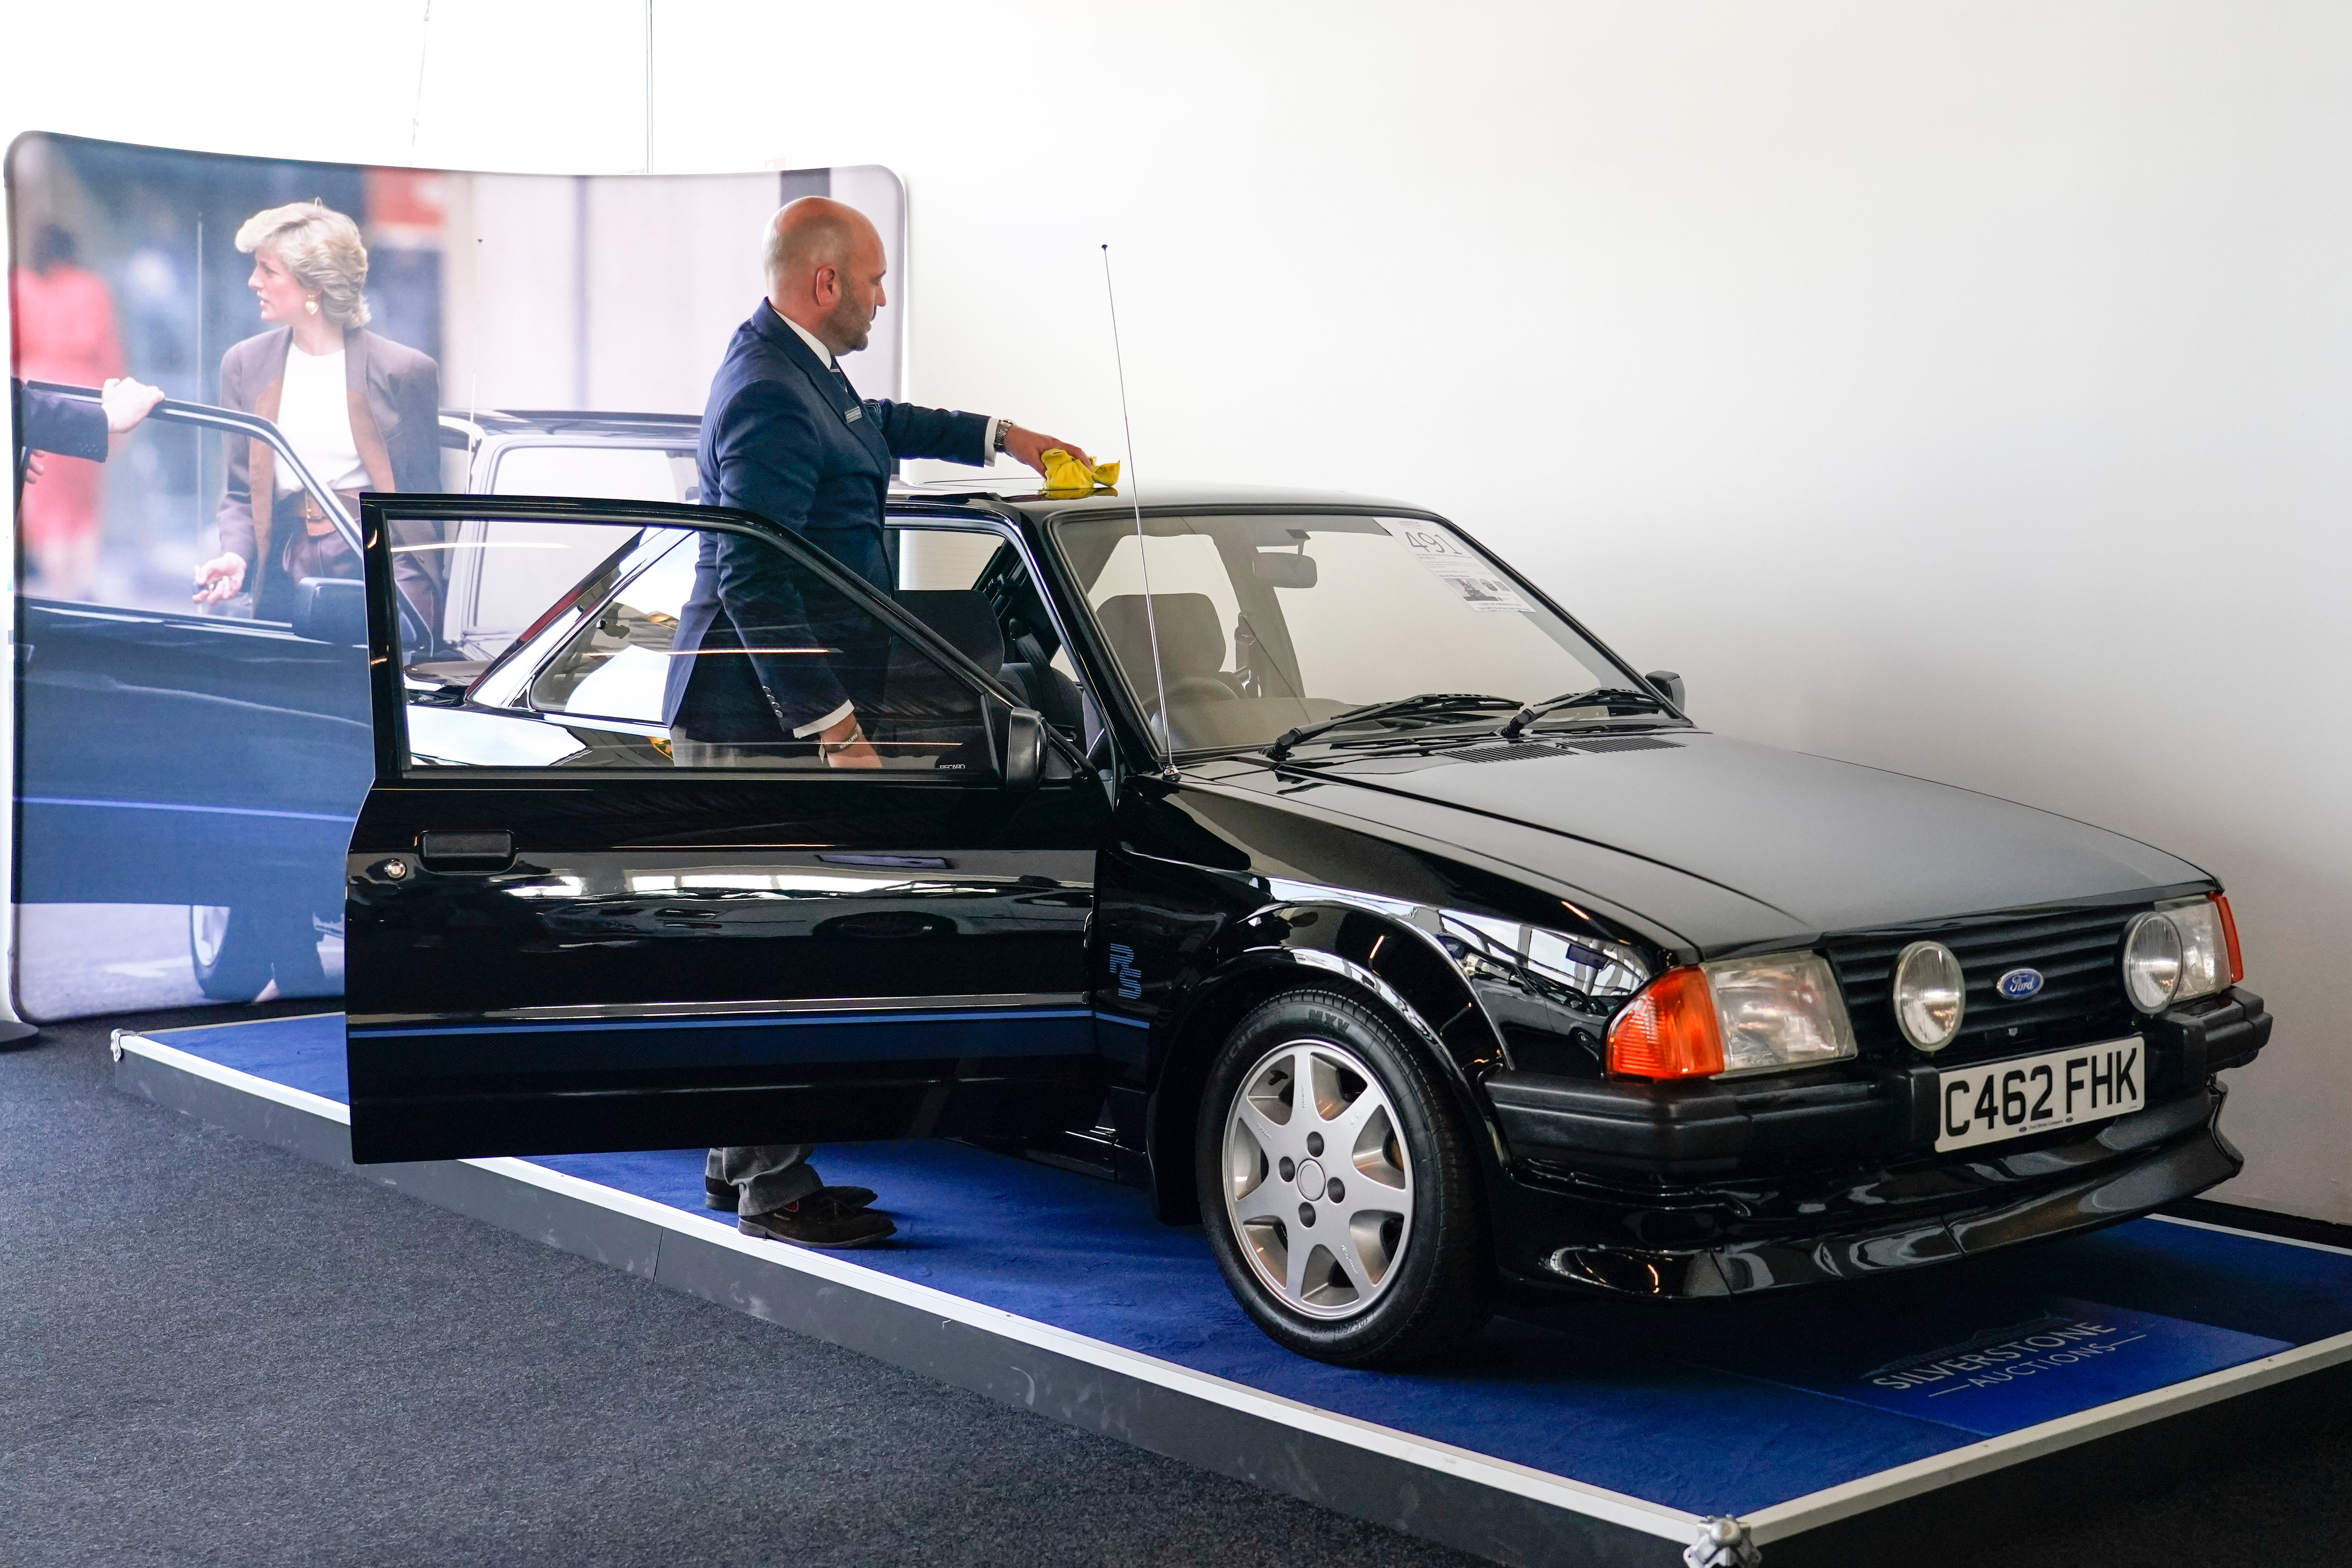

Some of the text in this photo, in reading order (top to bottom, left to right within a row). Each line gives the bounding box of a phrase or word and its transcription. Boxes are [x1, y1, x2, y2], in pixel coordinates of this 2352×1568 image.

[1405, 531, 1462, 555] 491
[1109, 943, 1142, 1000] RS
[2010, 975, 2034, 993] Ford
[1309, 1009, 1350, 1033] MXV
[1945, 1048, 2137, 1137] C462 FHK
[1872, 1322, 2117, 1389] SILVERSTONE
[1967, 1343, 2116, 1387] AUCTIONS
